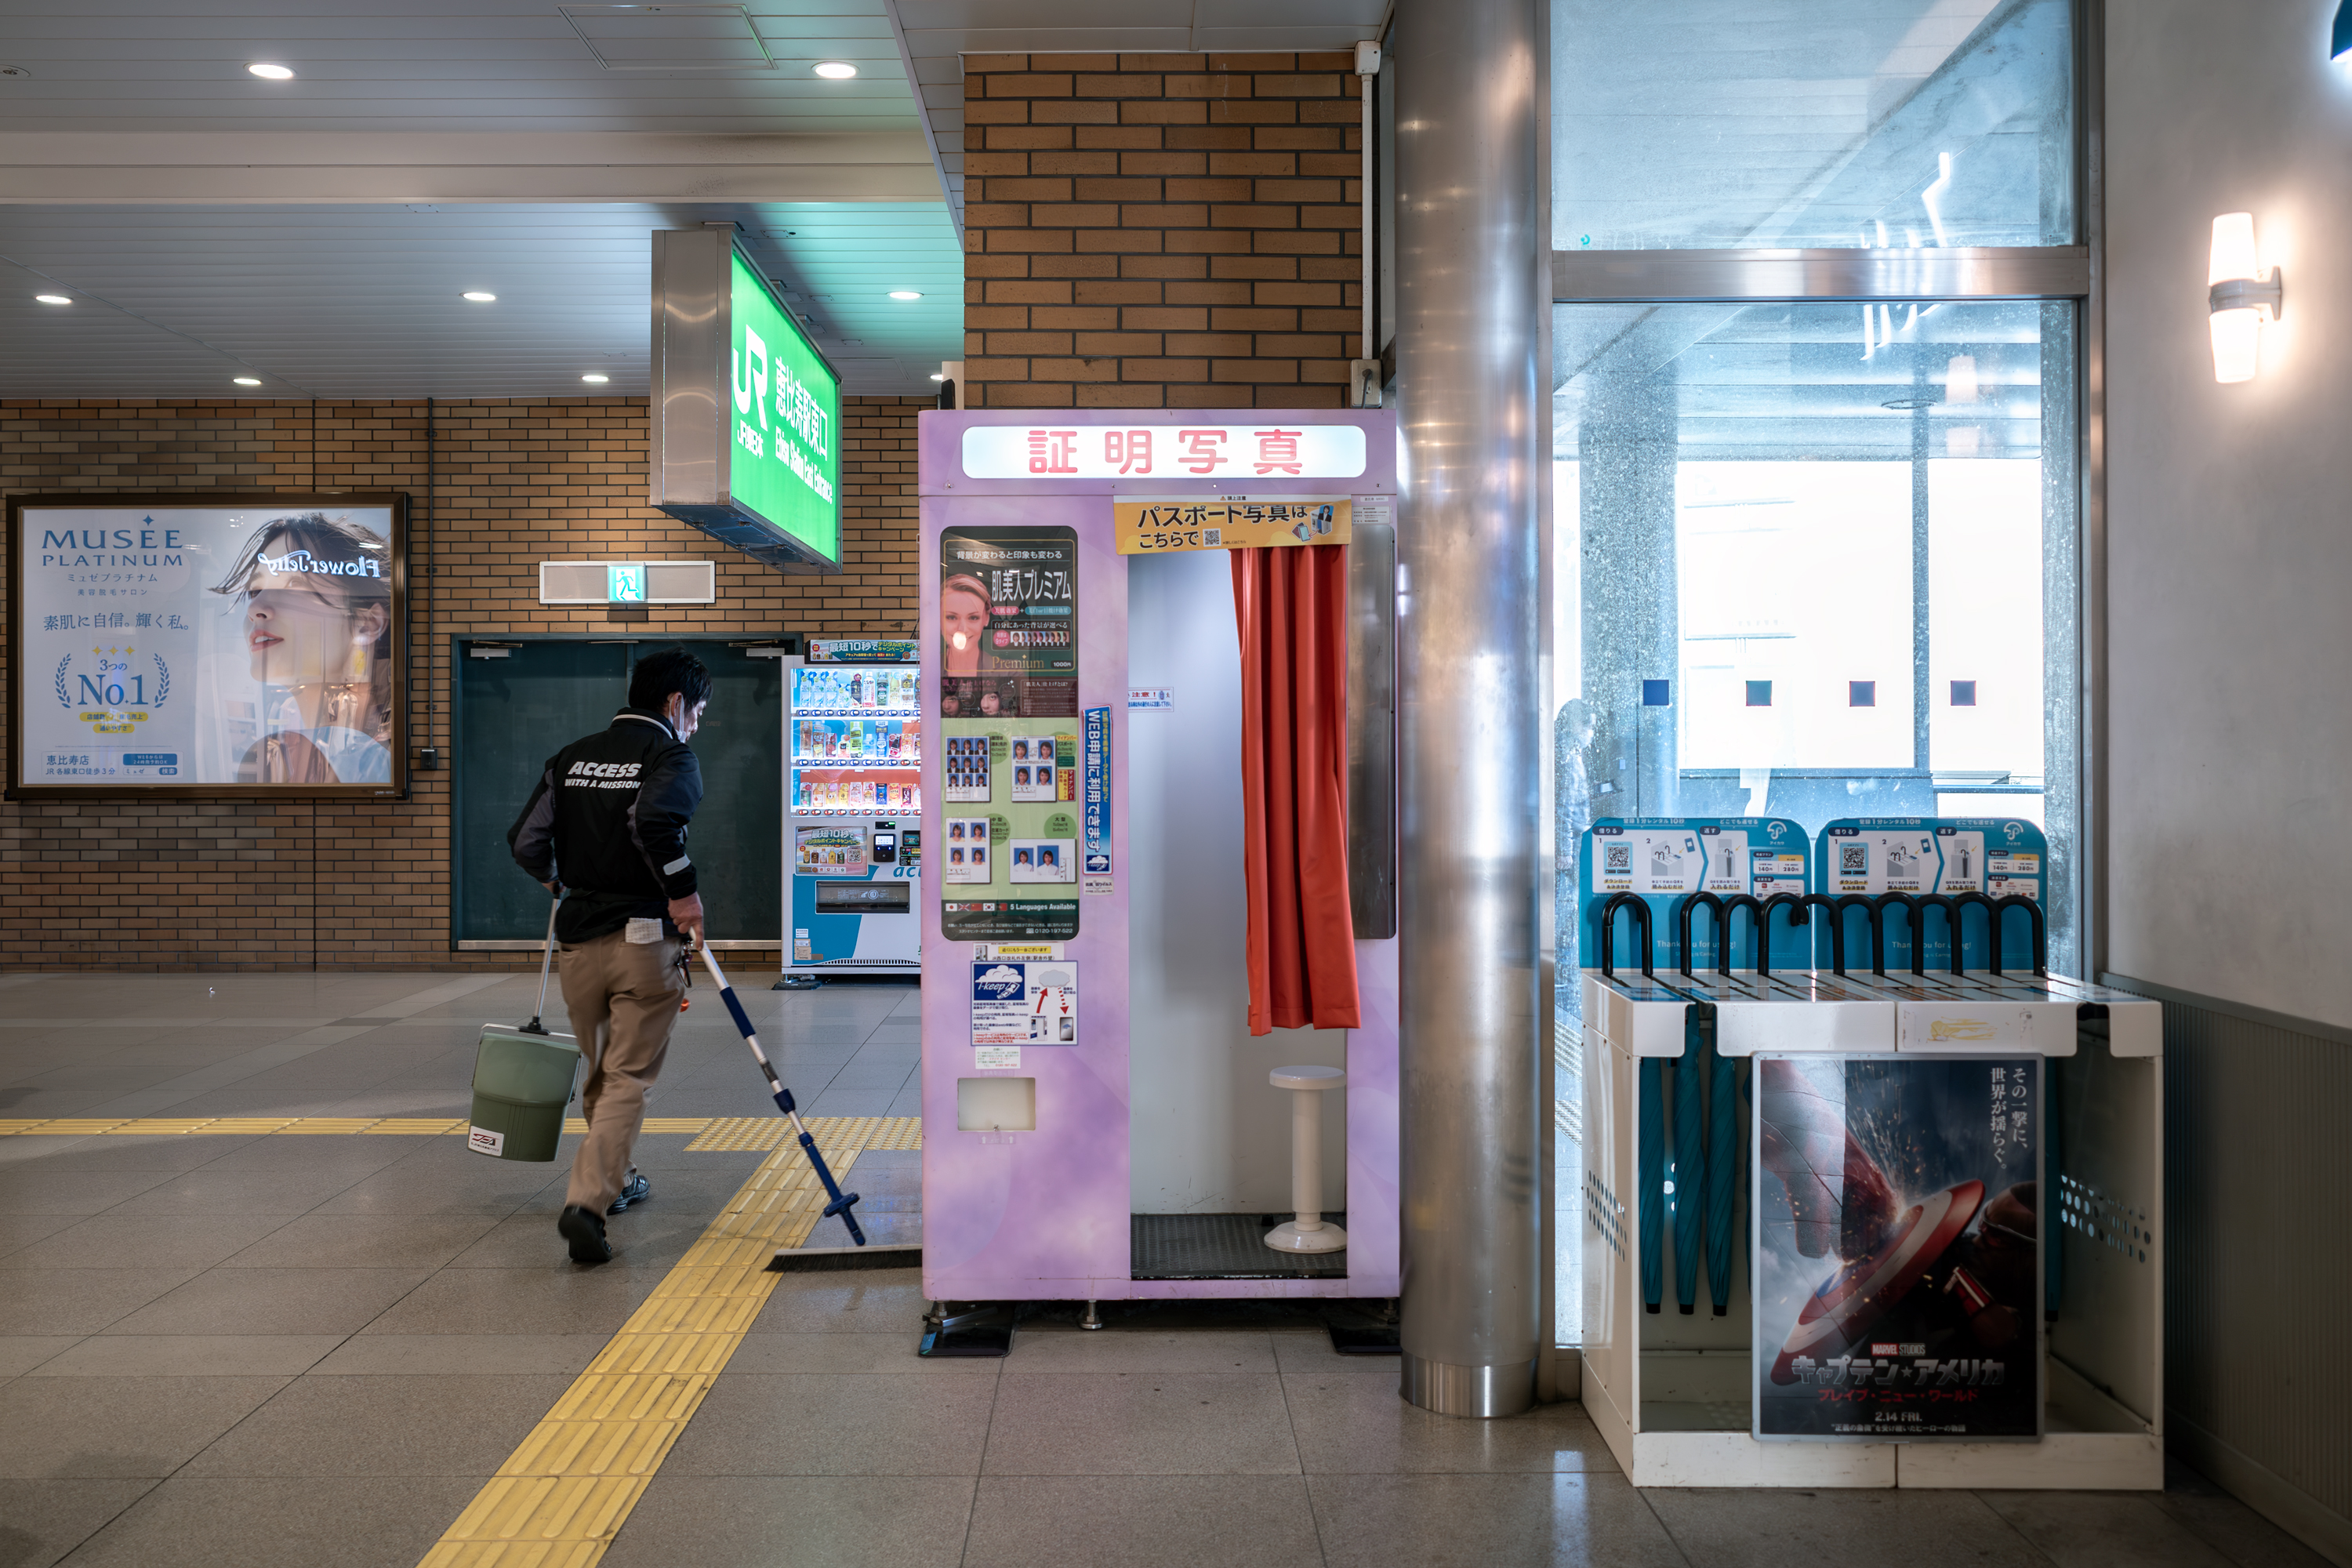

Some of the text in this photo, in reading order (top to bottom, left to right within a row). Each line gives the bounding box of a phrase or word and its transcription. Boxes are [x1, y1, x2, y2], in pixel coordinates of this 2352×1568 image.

[775, 356, 827, 461] 恵比寿駅東口
[737, 419, 764, 459] JR東日本
[1028, 429, 1302, 474] 証明写真
[775, 426, 833, 504] Ebisu Station East Entrance
[1137, 505, 1308, 528] パスポート写真は
[1139, 531, 1200, 549] こちらで
[42, 554, 183, 566] PLATINUM
[956, 550, 1062, 559] 背景が変わると印象も変わる
[67, 573, 158, 583] ミュゼプラチナム
[992, 568, 1072, 601] 肌美人プレミアム
[43, 612, 189, 632] 素肌に自信。輝く私。
[828, 641, 878, 652] 最短10秒で
[100, 659, 128, 671] 3つの
[992, 654, 1044, 669] Premium
[46, 755, 89, 766] 恵比寿店
[568, 761, 643, 778] ACCESS
[600, 781, 641, 789] MISSION
[1087, 710, 1101, 852] WEB申請に利用できます
[811, 829, 854, 839] 最短10秒で
[1016, 903, 1047, 912] Languages
[1934, 940, 1946, 949] for
[978, 982, 1005, 993] i-keep
[2011, 1068, 2028, 1149] その一撃に、
[1990, 1067, 2007, 1170] 世界が揺らぐ。
[1872, 1344, 1926, 1355] MARVEL STUDIOS
[1875, 1412, 1922, 1421] 2.14 FRI.
